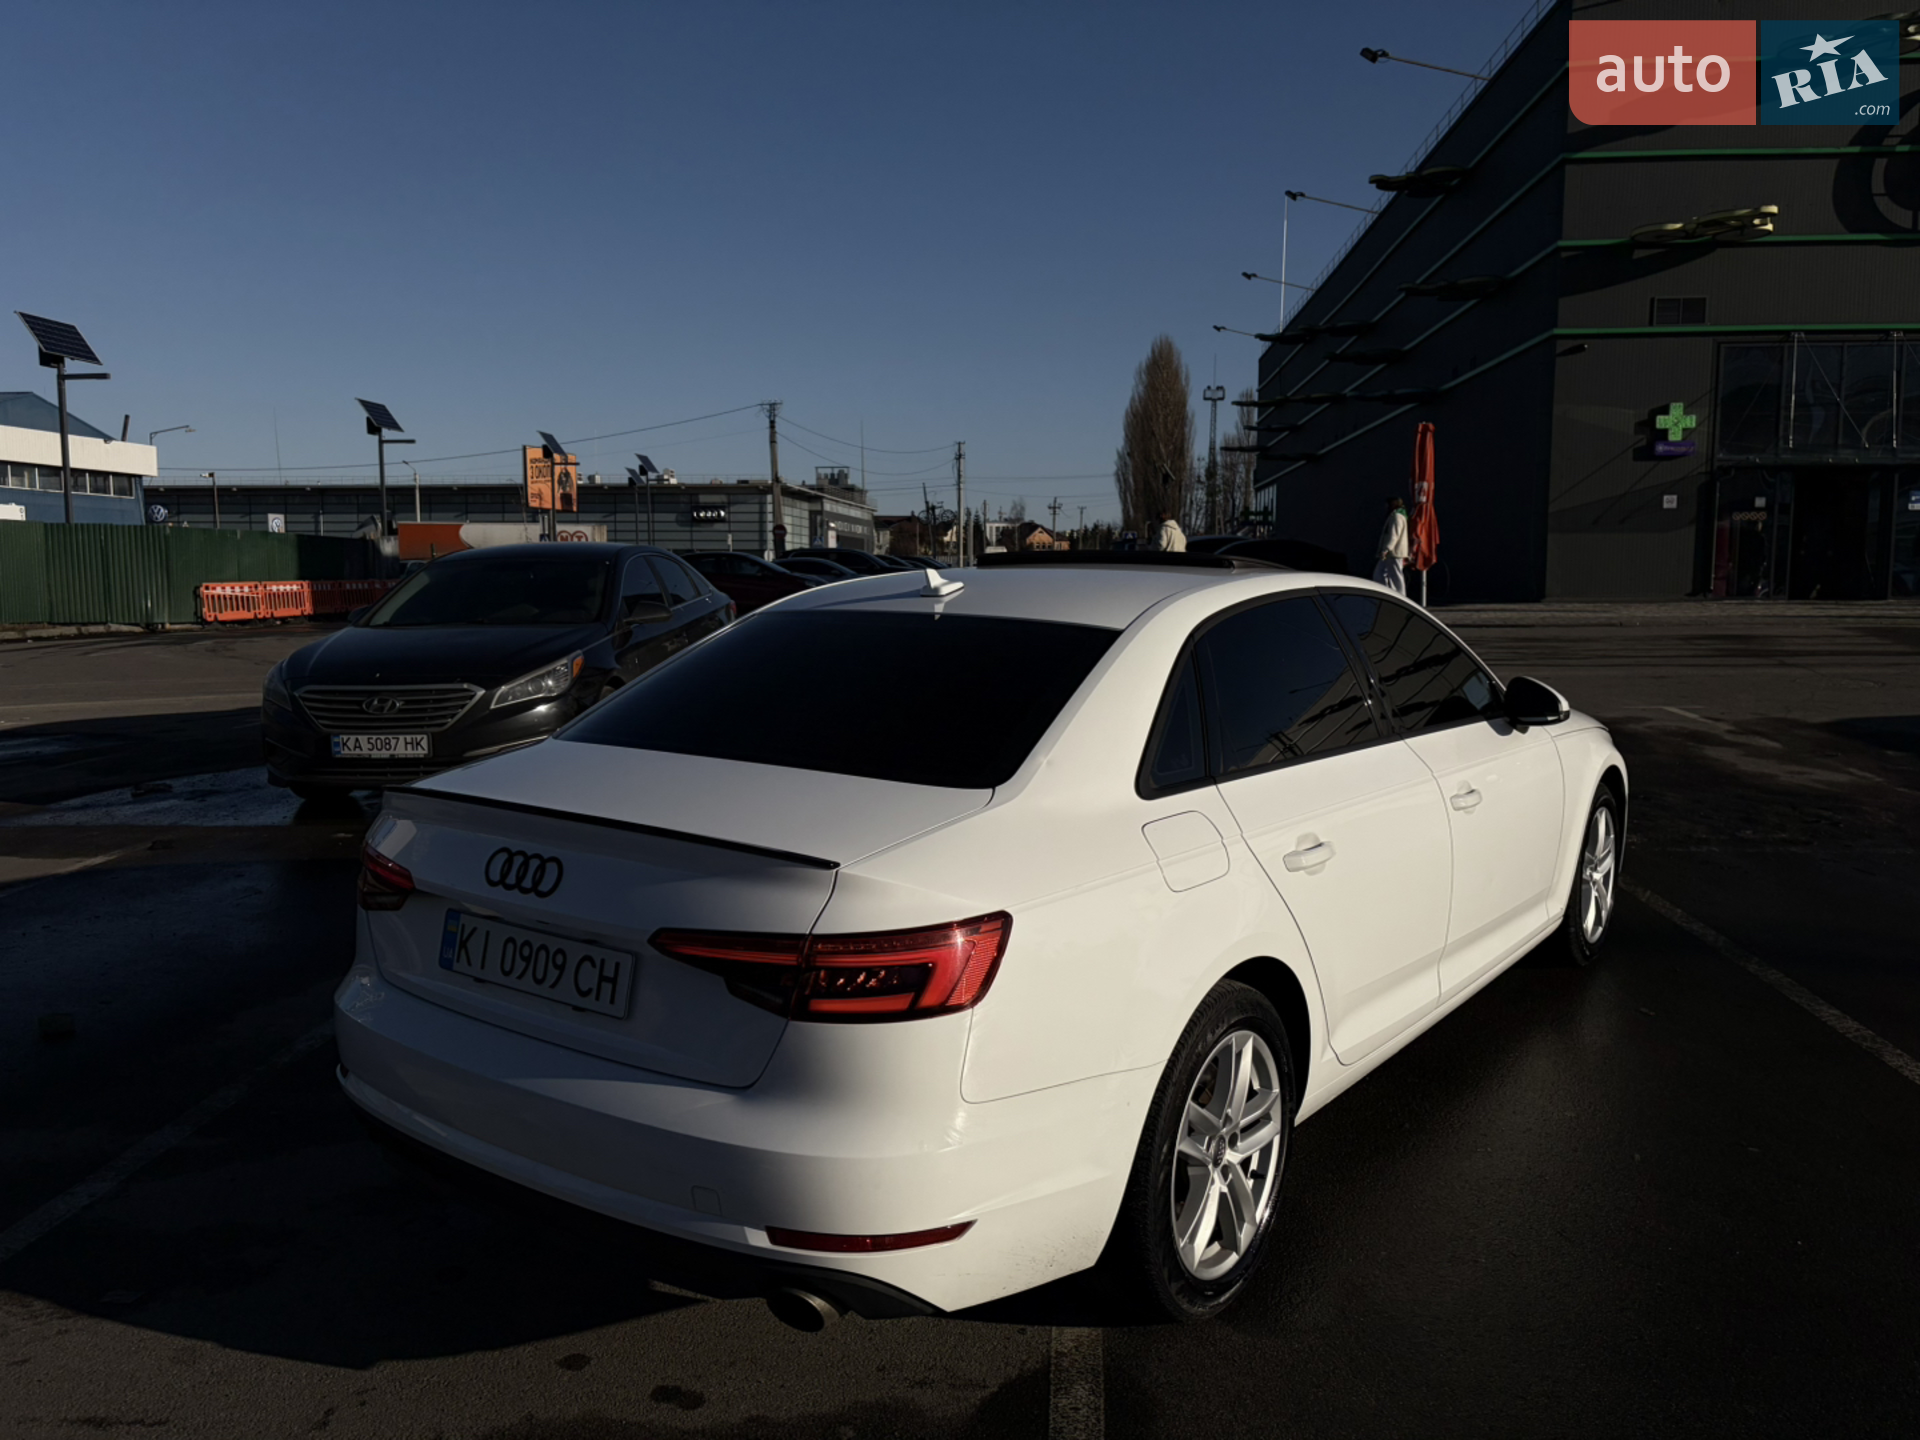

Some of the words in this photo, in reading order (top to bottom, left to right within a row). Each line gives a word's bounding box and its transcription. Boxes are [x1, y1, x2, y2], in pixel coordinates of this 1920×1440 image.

[341, 737, 363, 751] KA
[367, 737, 400, 751] 5087
[404, 736, 426, 751] HK
[456, 923, 490, 970] KI
[500, 936, 567, 989] 0909
[573, 954, 620, 1005] CH
